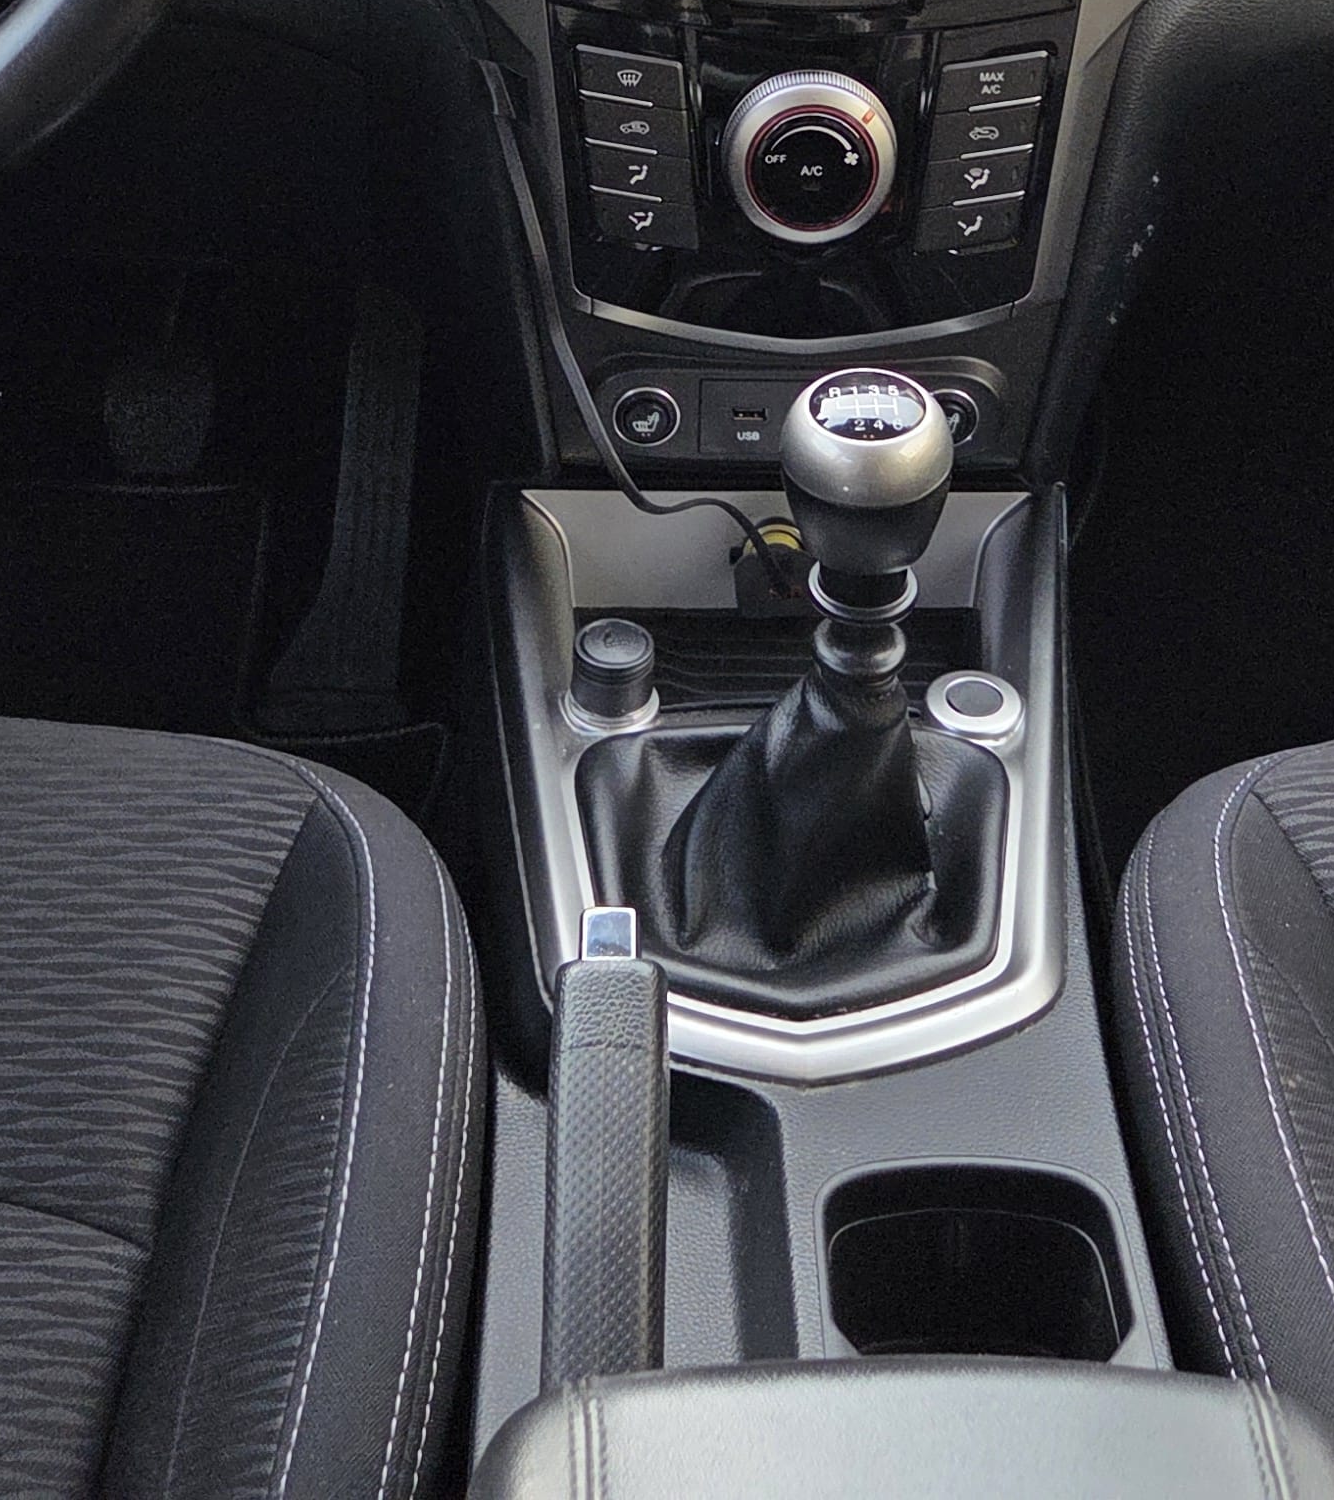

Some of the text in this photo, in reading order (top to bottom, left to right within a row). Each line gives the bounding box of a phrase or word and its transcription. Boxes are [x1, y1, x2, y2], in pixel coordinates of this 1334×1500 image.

[979, 71, 1005, 82] MAX
[980, 84, 1002, 95] A/C
[764, 154, 787, 165] OFF
[800, 165, 823, 177] A/C
[853, 418, 866, 431] 2
[873, 418, 884, 431] 4
[736, 431, 760, 441] USB
